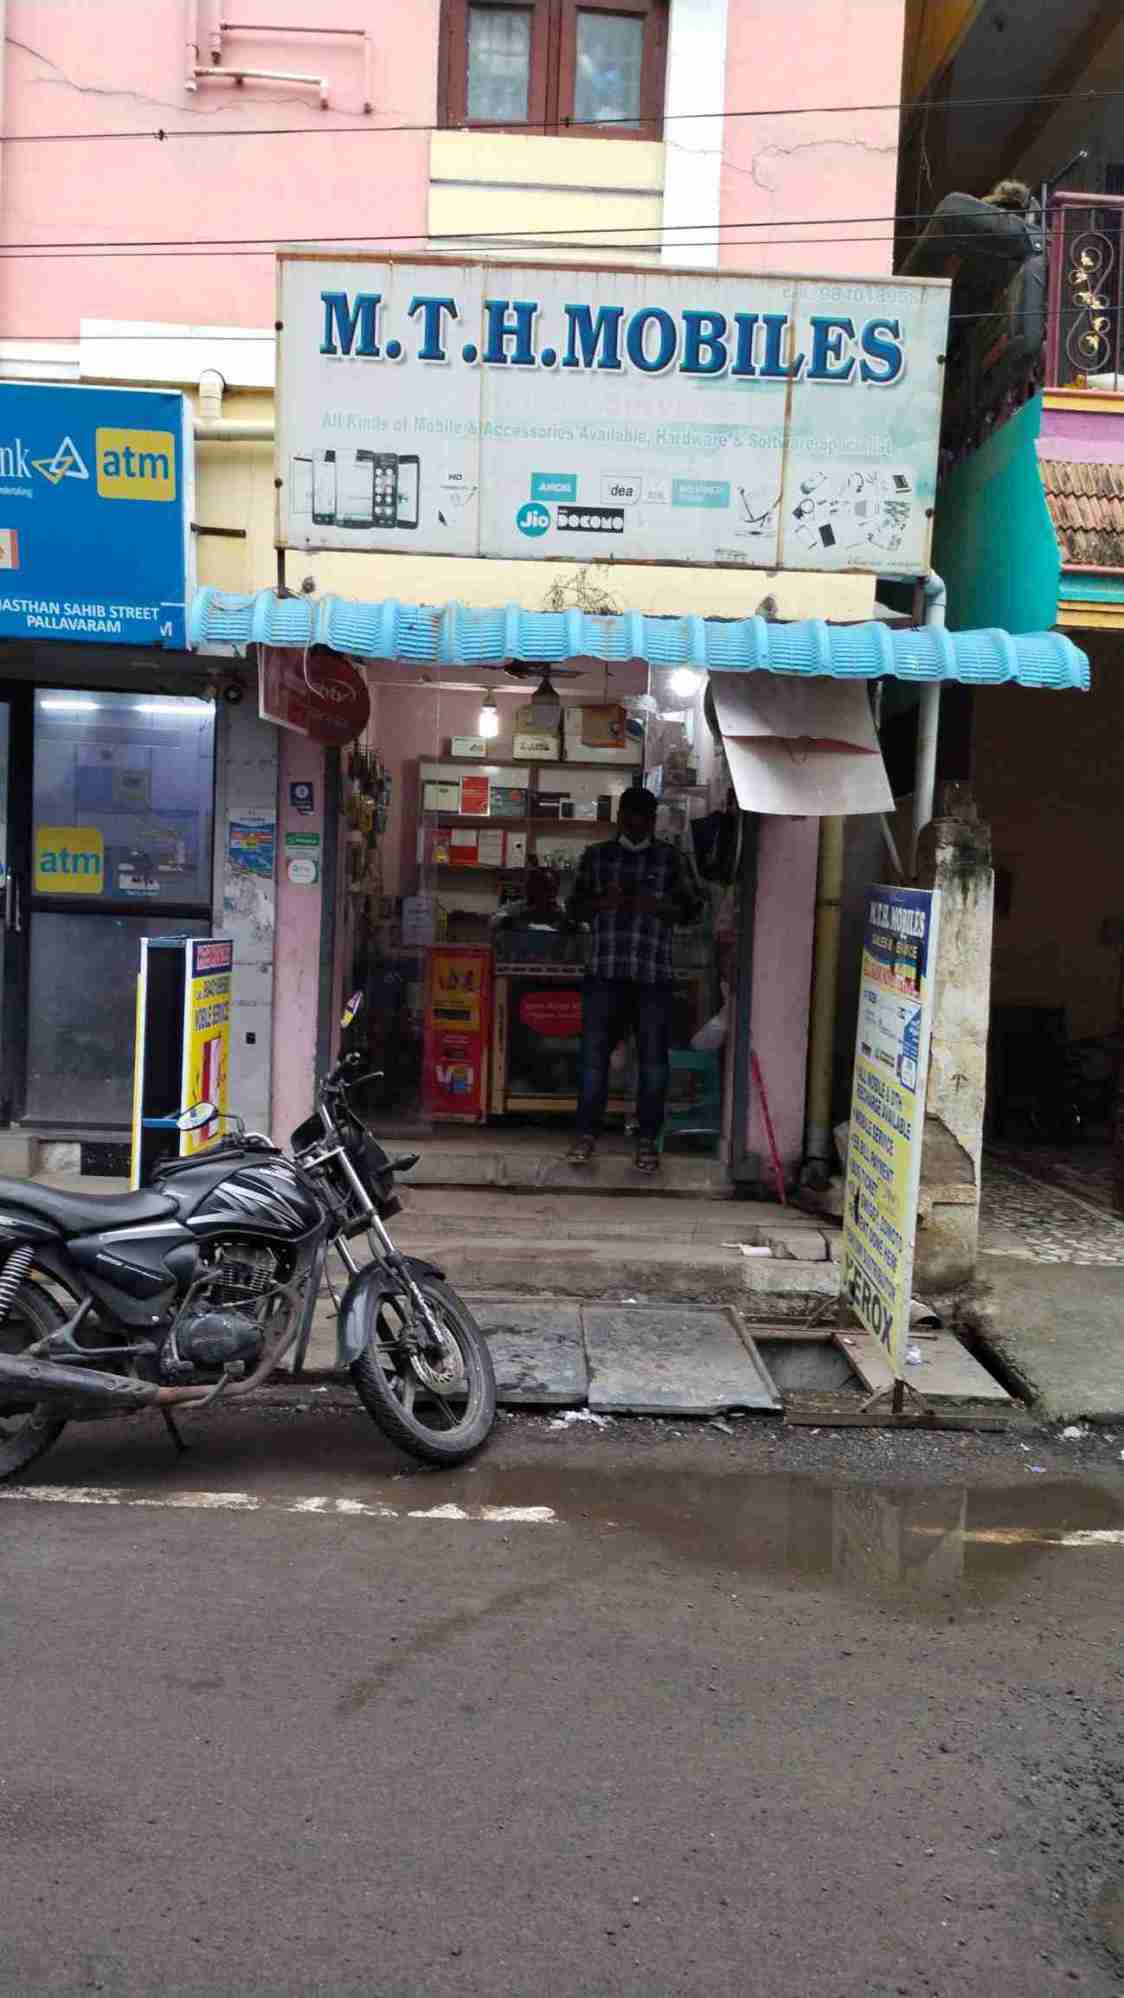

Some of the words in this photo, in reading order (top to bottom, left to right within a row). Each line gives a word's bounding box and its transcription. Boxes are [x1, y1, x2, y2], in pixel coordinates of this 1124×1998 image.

[482, 419, 573, 440] Accessories
[103, 446, 169, 480] atm
[606, 485, 634, 497] dea
[519, 510, 549, 529] Jio
[0, 598, 60, 615] ASTHAN
[64, 602, 106, 617] SAHIB
[109, 605, 160, 620] STREET
[26, 614, 121, 634] PALLAVARAM
[40, 847, 101, 875] atm
